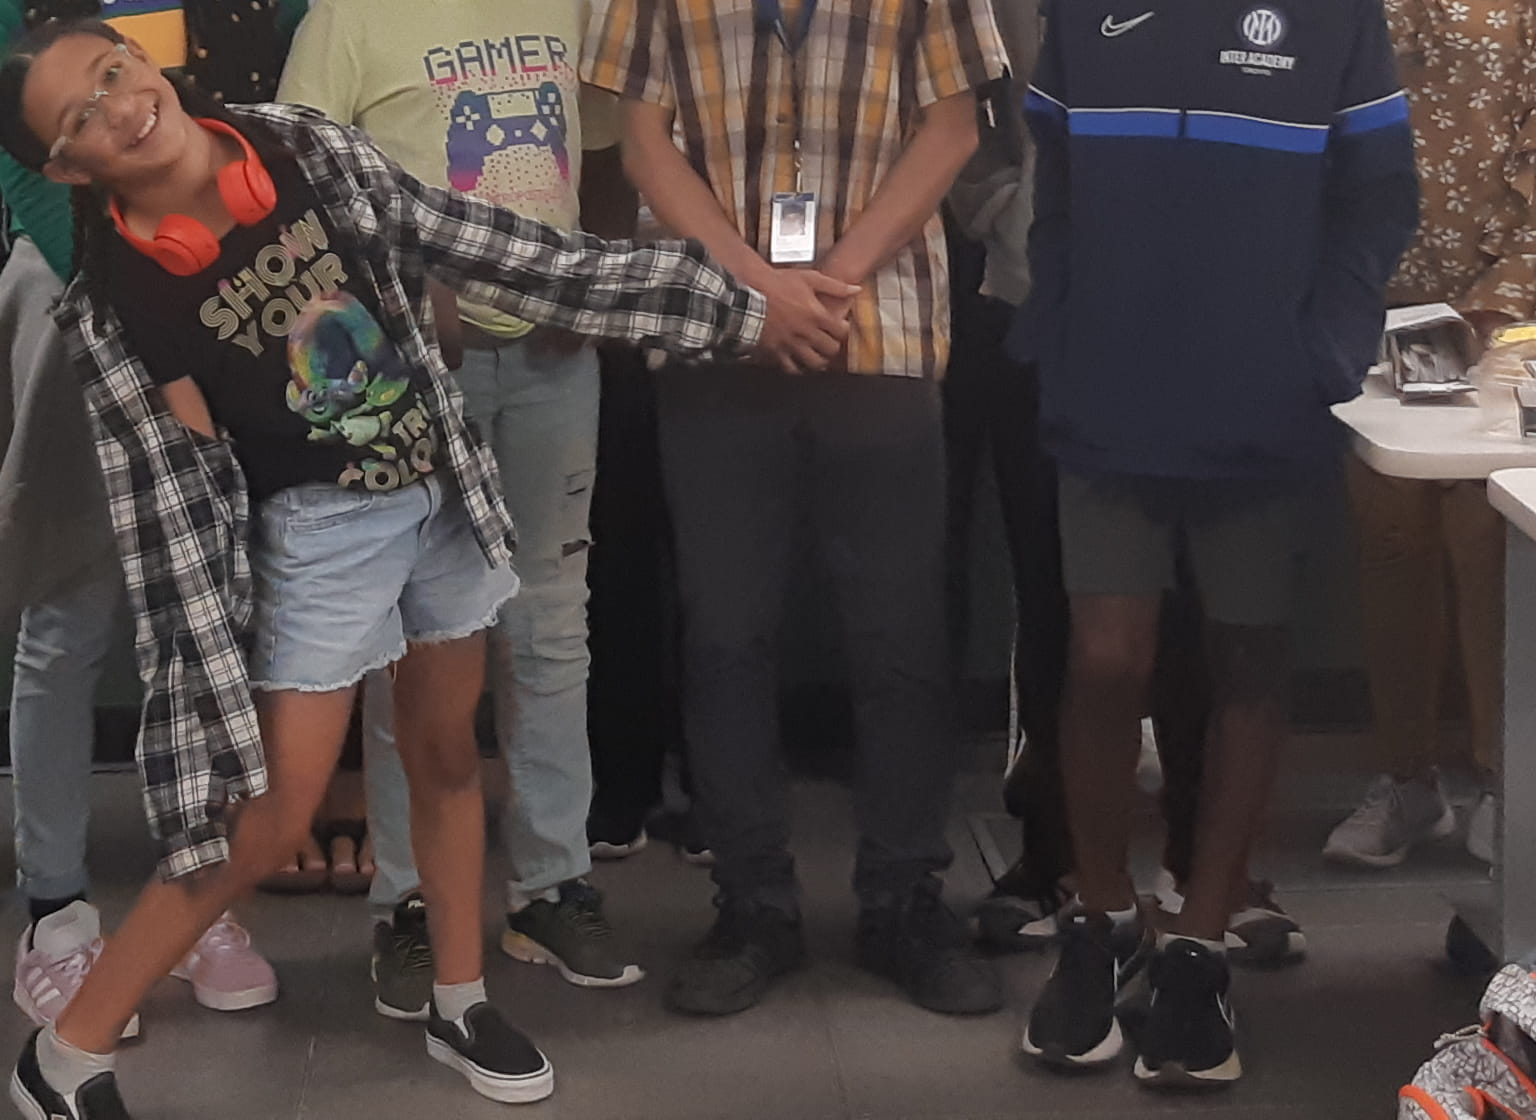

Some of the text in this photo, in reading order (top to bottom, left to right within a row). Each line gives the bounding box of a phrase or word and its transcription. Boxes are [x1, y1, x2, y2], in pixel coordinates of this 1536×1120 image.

[423, 34, 569, 86] GAMER
[199, 208, 329, 340] SHOW
[231, 252, 349, 358] YOUR
